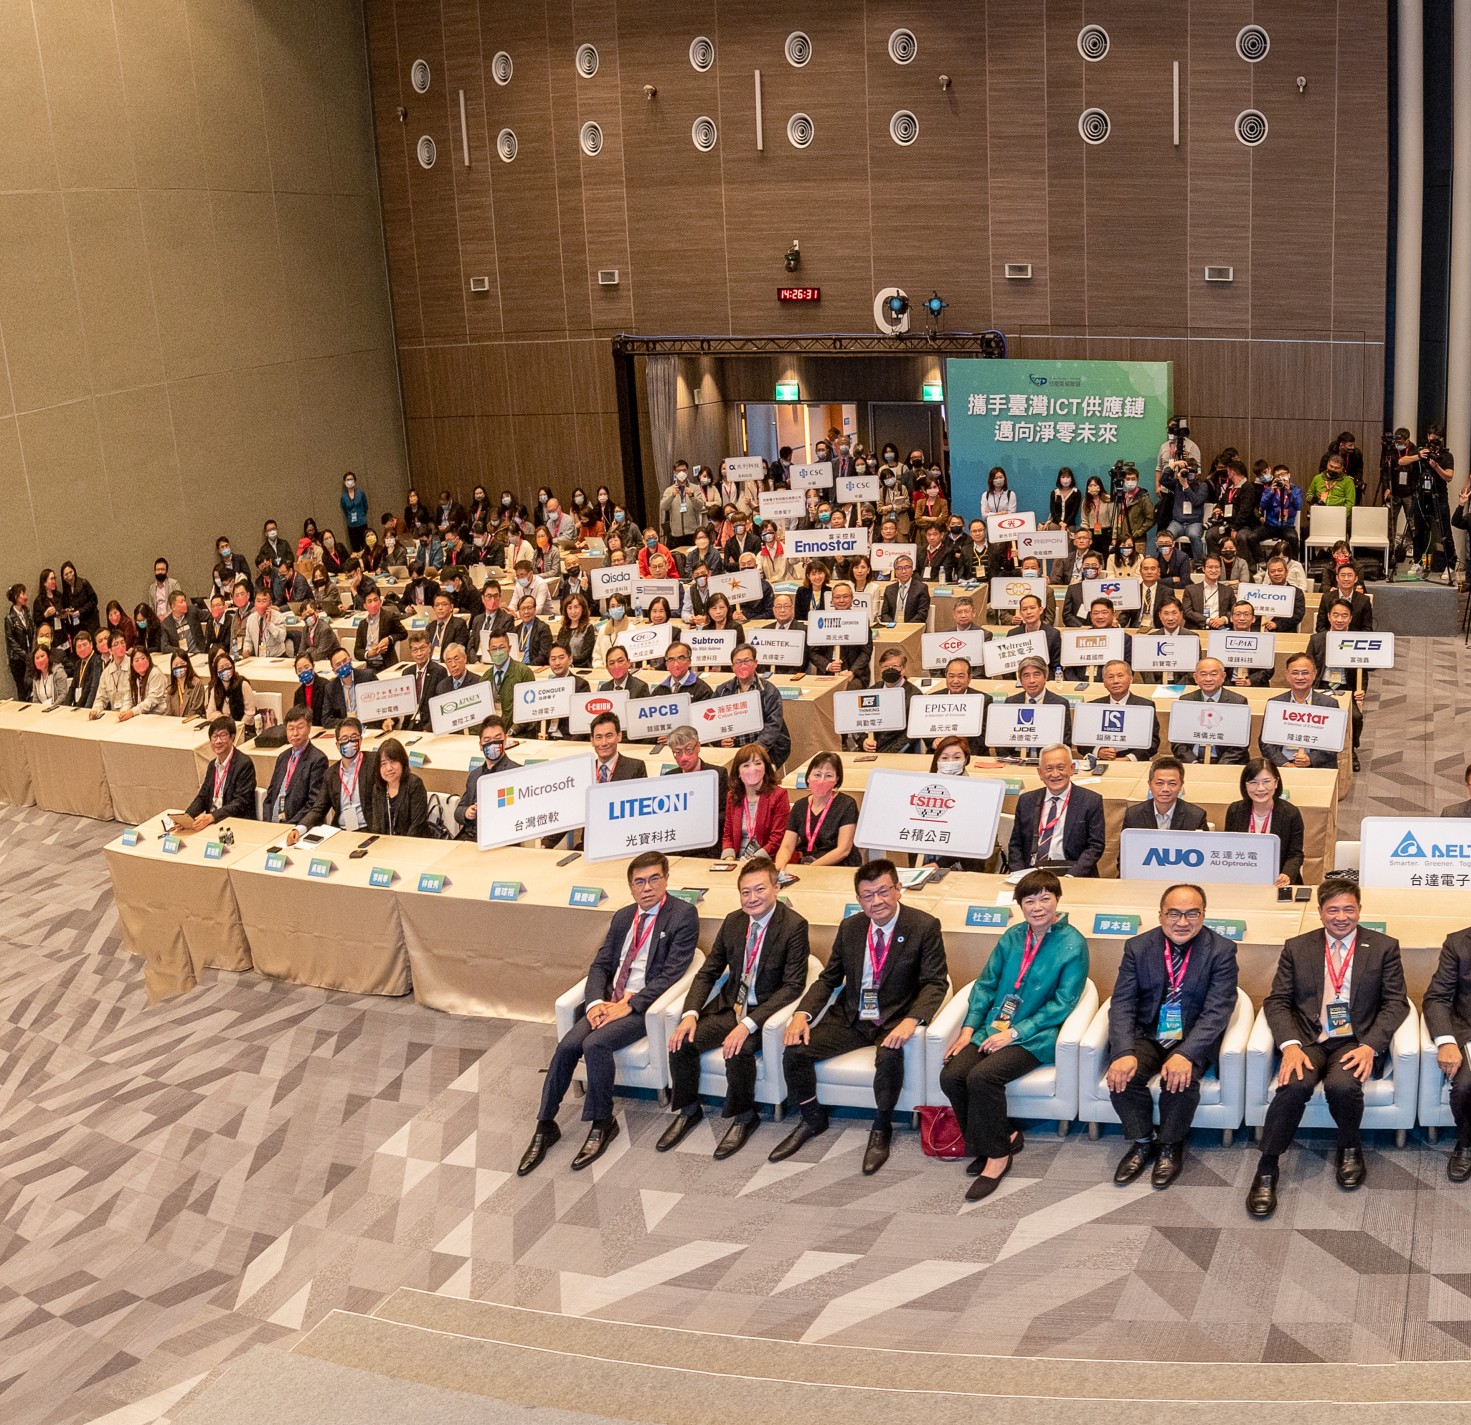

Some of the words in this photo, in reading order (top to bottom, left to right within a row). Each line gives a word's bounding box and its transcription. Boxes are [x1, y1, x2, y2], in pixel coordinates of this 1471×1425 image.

[781, 289, 817, 299] 14:26:31
[873, 287, 911, 335] G
[968, 394, 1145, 418] 攜手臺灣ICT供應鏈
[994, 421, 1118, 443] 邁向淨零未來
[809, 468, 823, 476] CSC
[856, 481, 871, 489] CSC
[828, 532, 856, 541] 富采控股
[794, 539, 857, 553] Ennostar
[601, 572, 631, 584] Qisda
[1100, 582, 1121, 593] ECS
[1244, 588, 1287, 601] Micron
[691, 636, 724, 646] Subtron
[760, 639, 790, 647] LINETEK
[944, 641, 963, 650] CCP
[1229, 639, 1253, 648] U-PAK
[1339, 639, 1383, 650] FCS
[998, 646, 1035, 659] 偉詮電子
[538, 686, 566, 696] CONQUER
[586, 702, 613, 712] I-CHIUN
[638, 703, 679, 719] APCB
[925, 703, 967, 713] EPISTAR
[1282, 709, 1329, 725] Lextar
[929, 723, 959, 732] 晶元光電
[1008, 734, 1039, 742] 湧德電子
[1193, 731, 1224, 741] 瑞儀光電
[1287, 733, 1318, 744] 隆達電子
[518, 776, 576, 800] Microsoft
[609, 792, 688, 821] LITEON
[909, 793, 956, 809] tsmc
[514, 811, 560, 832] 台灣微軟
[625, 829, 677, 848] 光寶科技
[899, 827, 951, 844] 台積公司
[1142, 847, 1205, 868] AUO
[1210, 850, 1258, 860] 友達光電
[1222, 860, 1258, 868] Optronics
[1410, 873, 1471, 887] 台達電子
[1332, 1019, 1348, 1027] VIP
